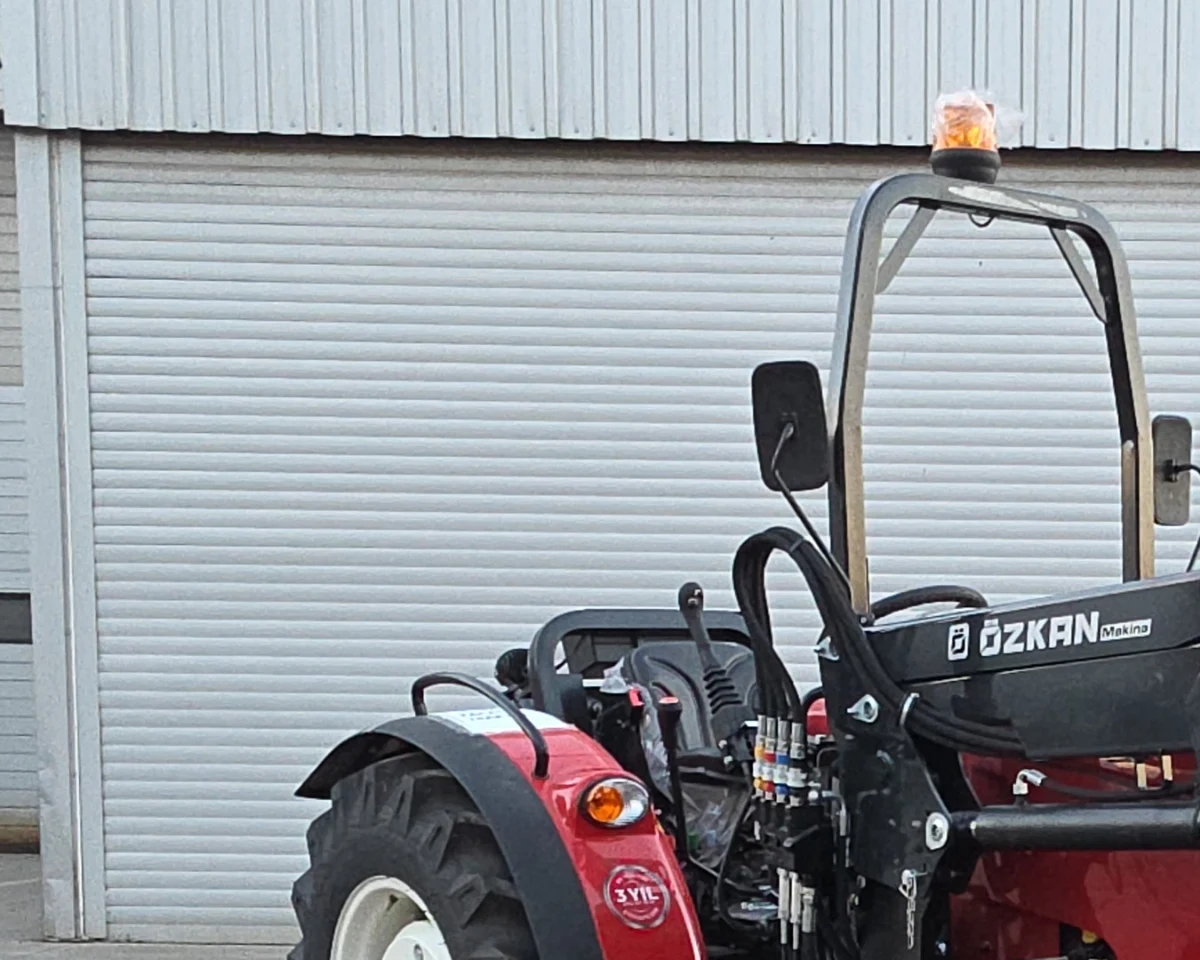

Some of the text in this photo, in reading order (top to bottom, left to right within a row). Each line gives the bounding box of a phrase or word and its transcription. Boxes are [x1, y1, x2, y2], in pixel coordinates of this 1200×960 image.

[979, 611, 1099, 656] ÖZKAN
[1102, 624, 1149, 638] Makina
[614, 886, 659, 903] 3 YIL
